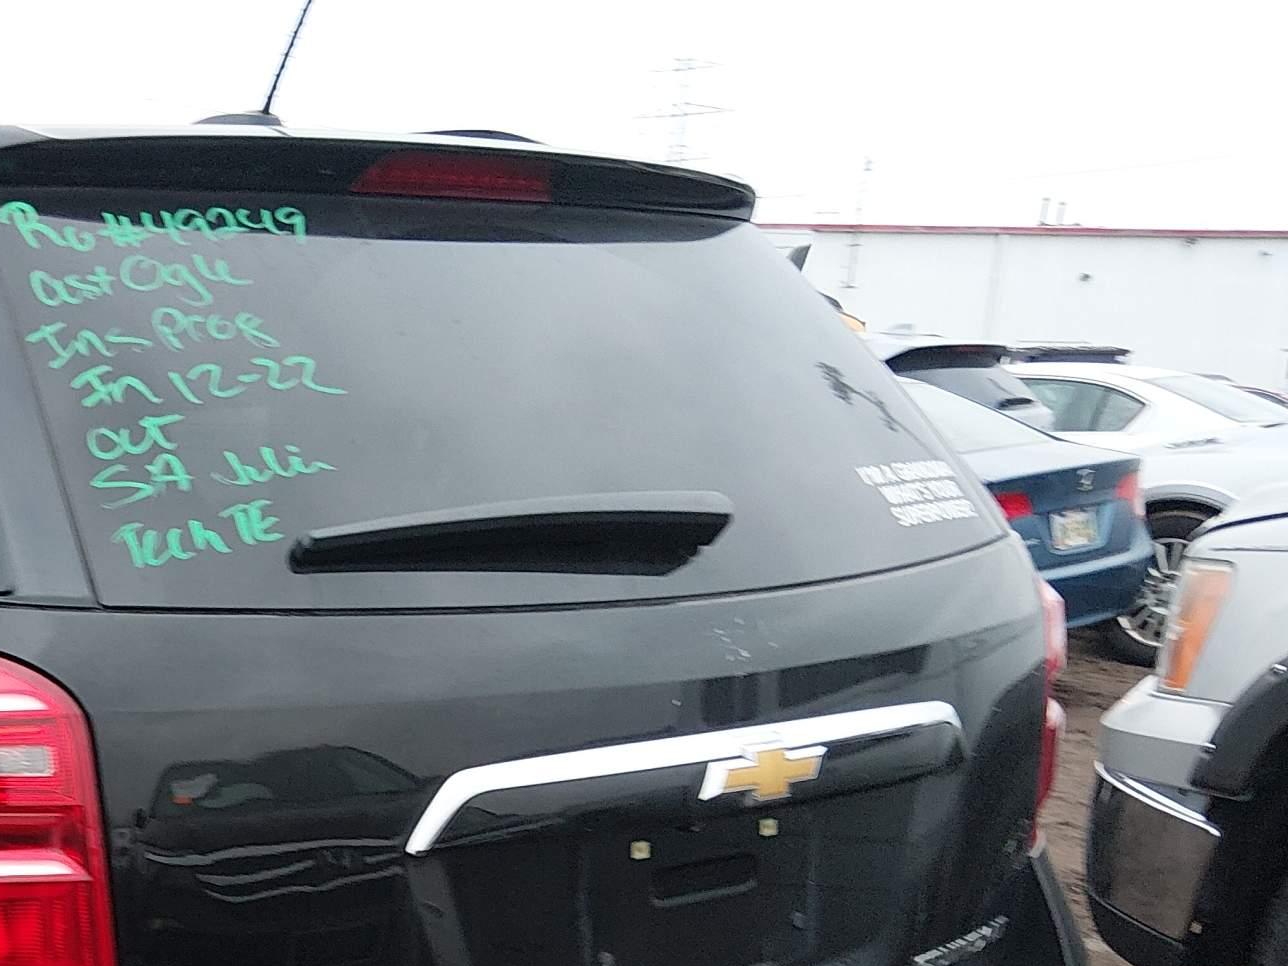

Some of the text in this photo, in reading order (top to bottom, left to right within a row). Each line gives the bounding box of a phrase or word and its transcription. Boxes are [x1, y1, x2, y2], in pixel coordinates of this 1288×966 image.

[70, 355, 349, 408] In 12-22
[89, 453, 195, 509] SA
[112, 519, 232, 568] Tech
